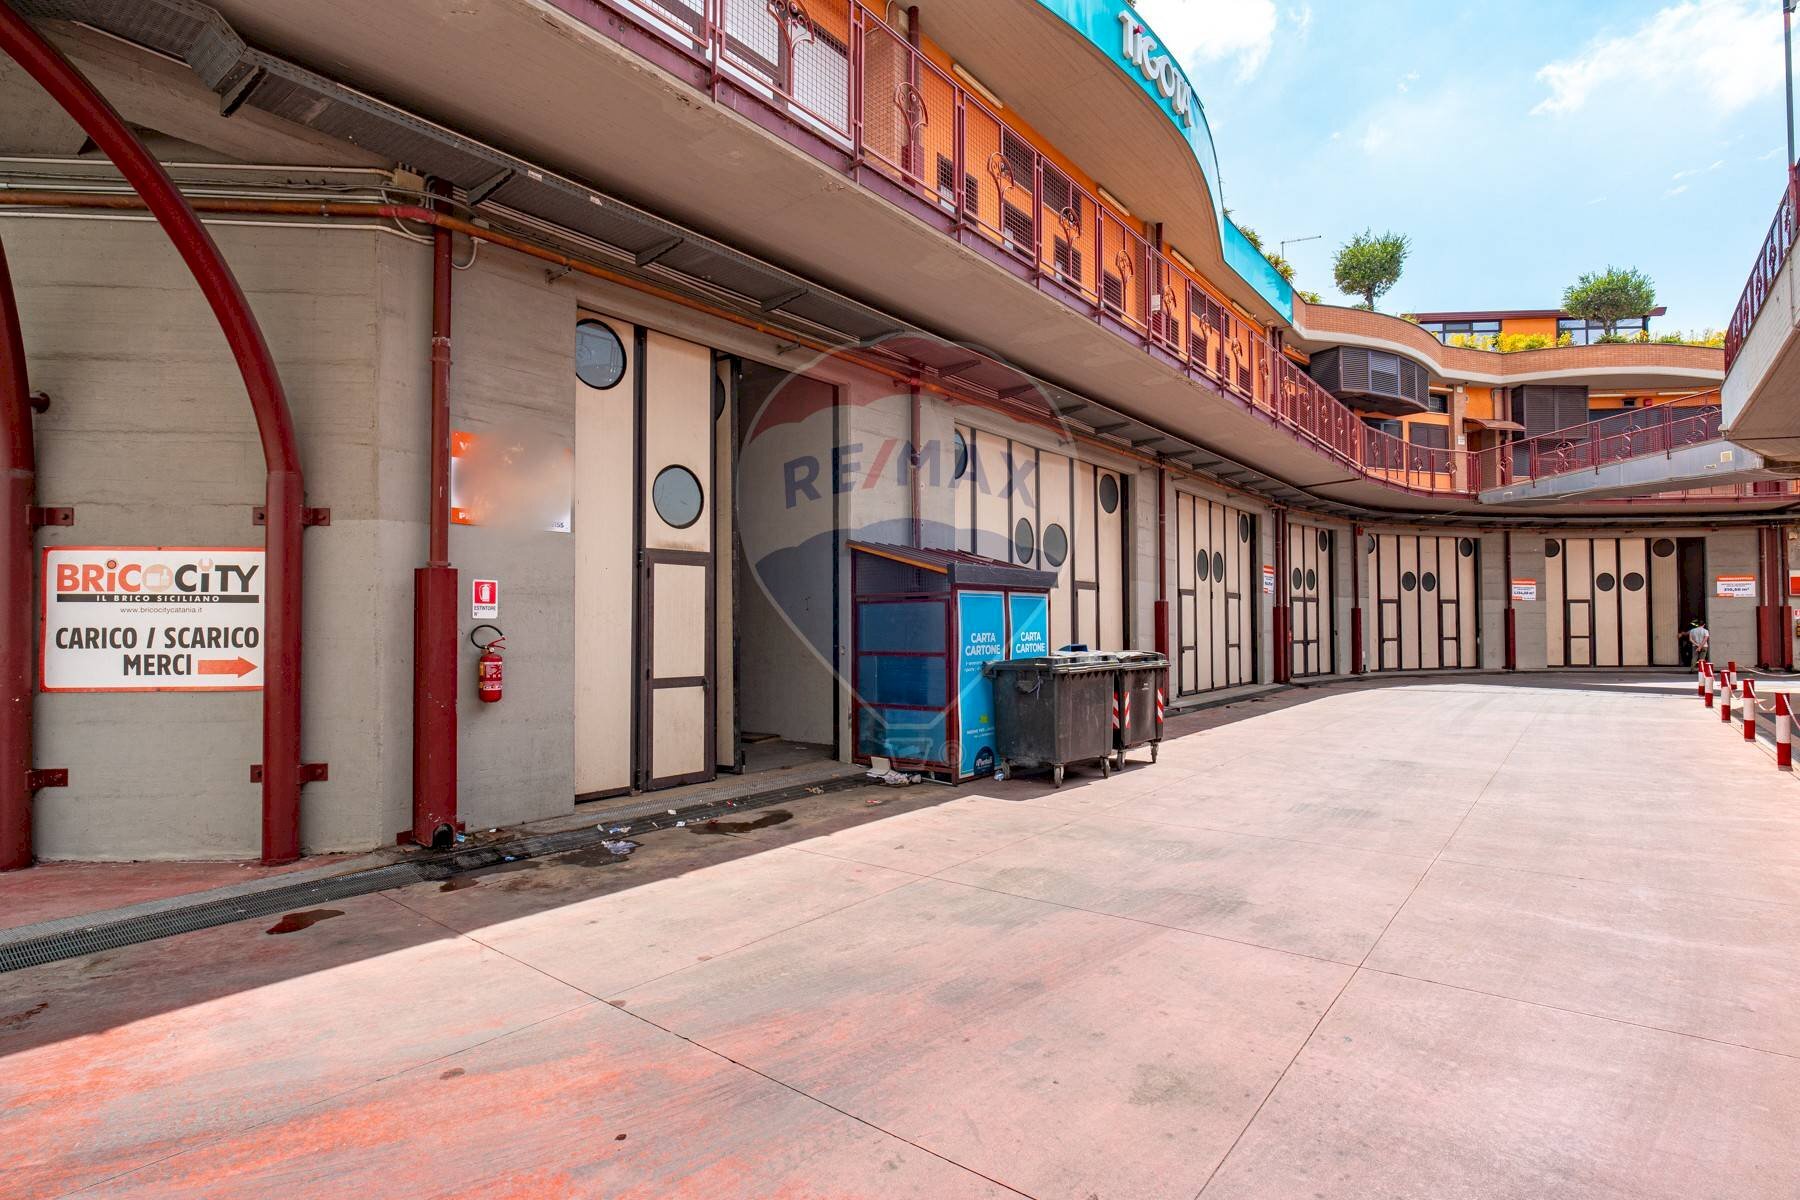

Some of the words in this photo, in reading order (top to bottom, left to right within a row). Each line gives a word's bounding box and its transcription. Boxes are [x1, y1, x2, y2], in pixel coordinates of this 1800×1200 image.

[55, 627, 138, 649] CARICO
[164, 626, 260, 649] SCARICO
[970, 633, 996, 643] CARTA
[1020, 631, 1041, 641] CARTA
[965, 644, 1001, 656] CARTONE
[1015, 643, 1046, 653] CARTONE
[123, 654, 192, 676] MERCI
